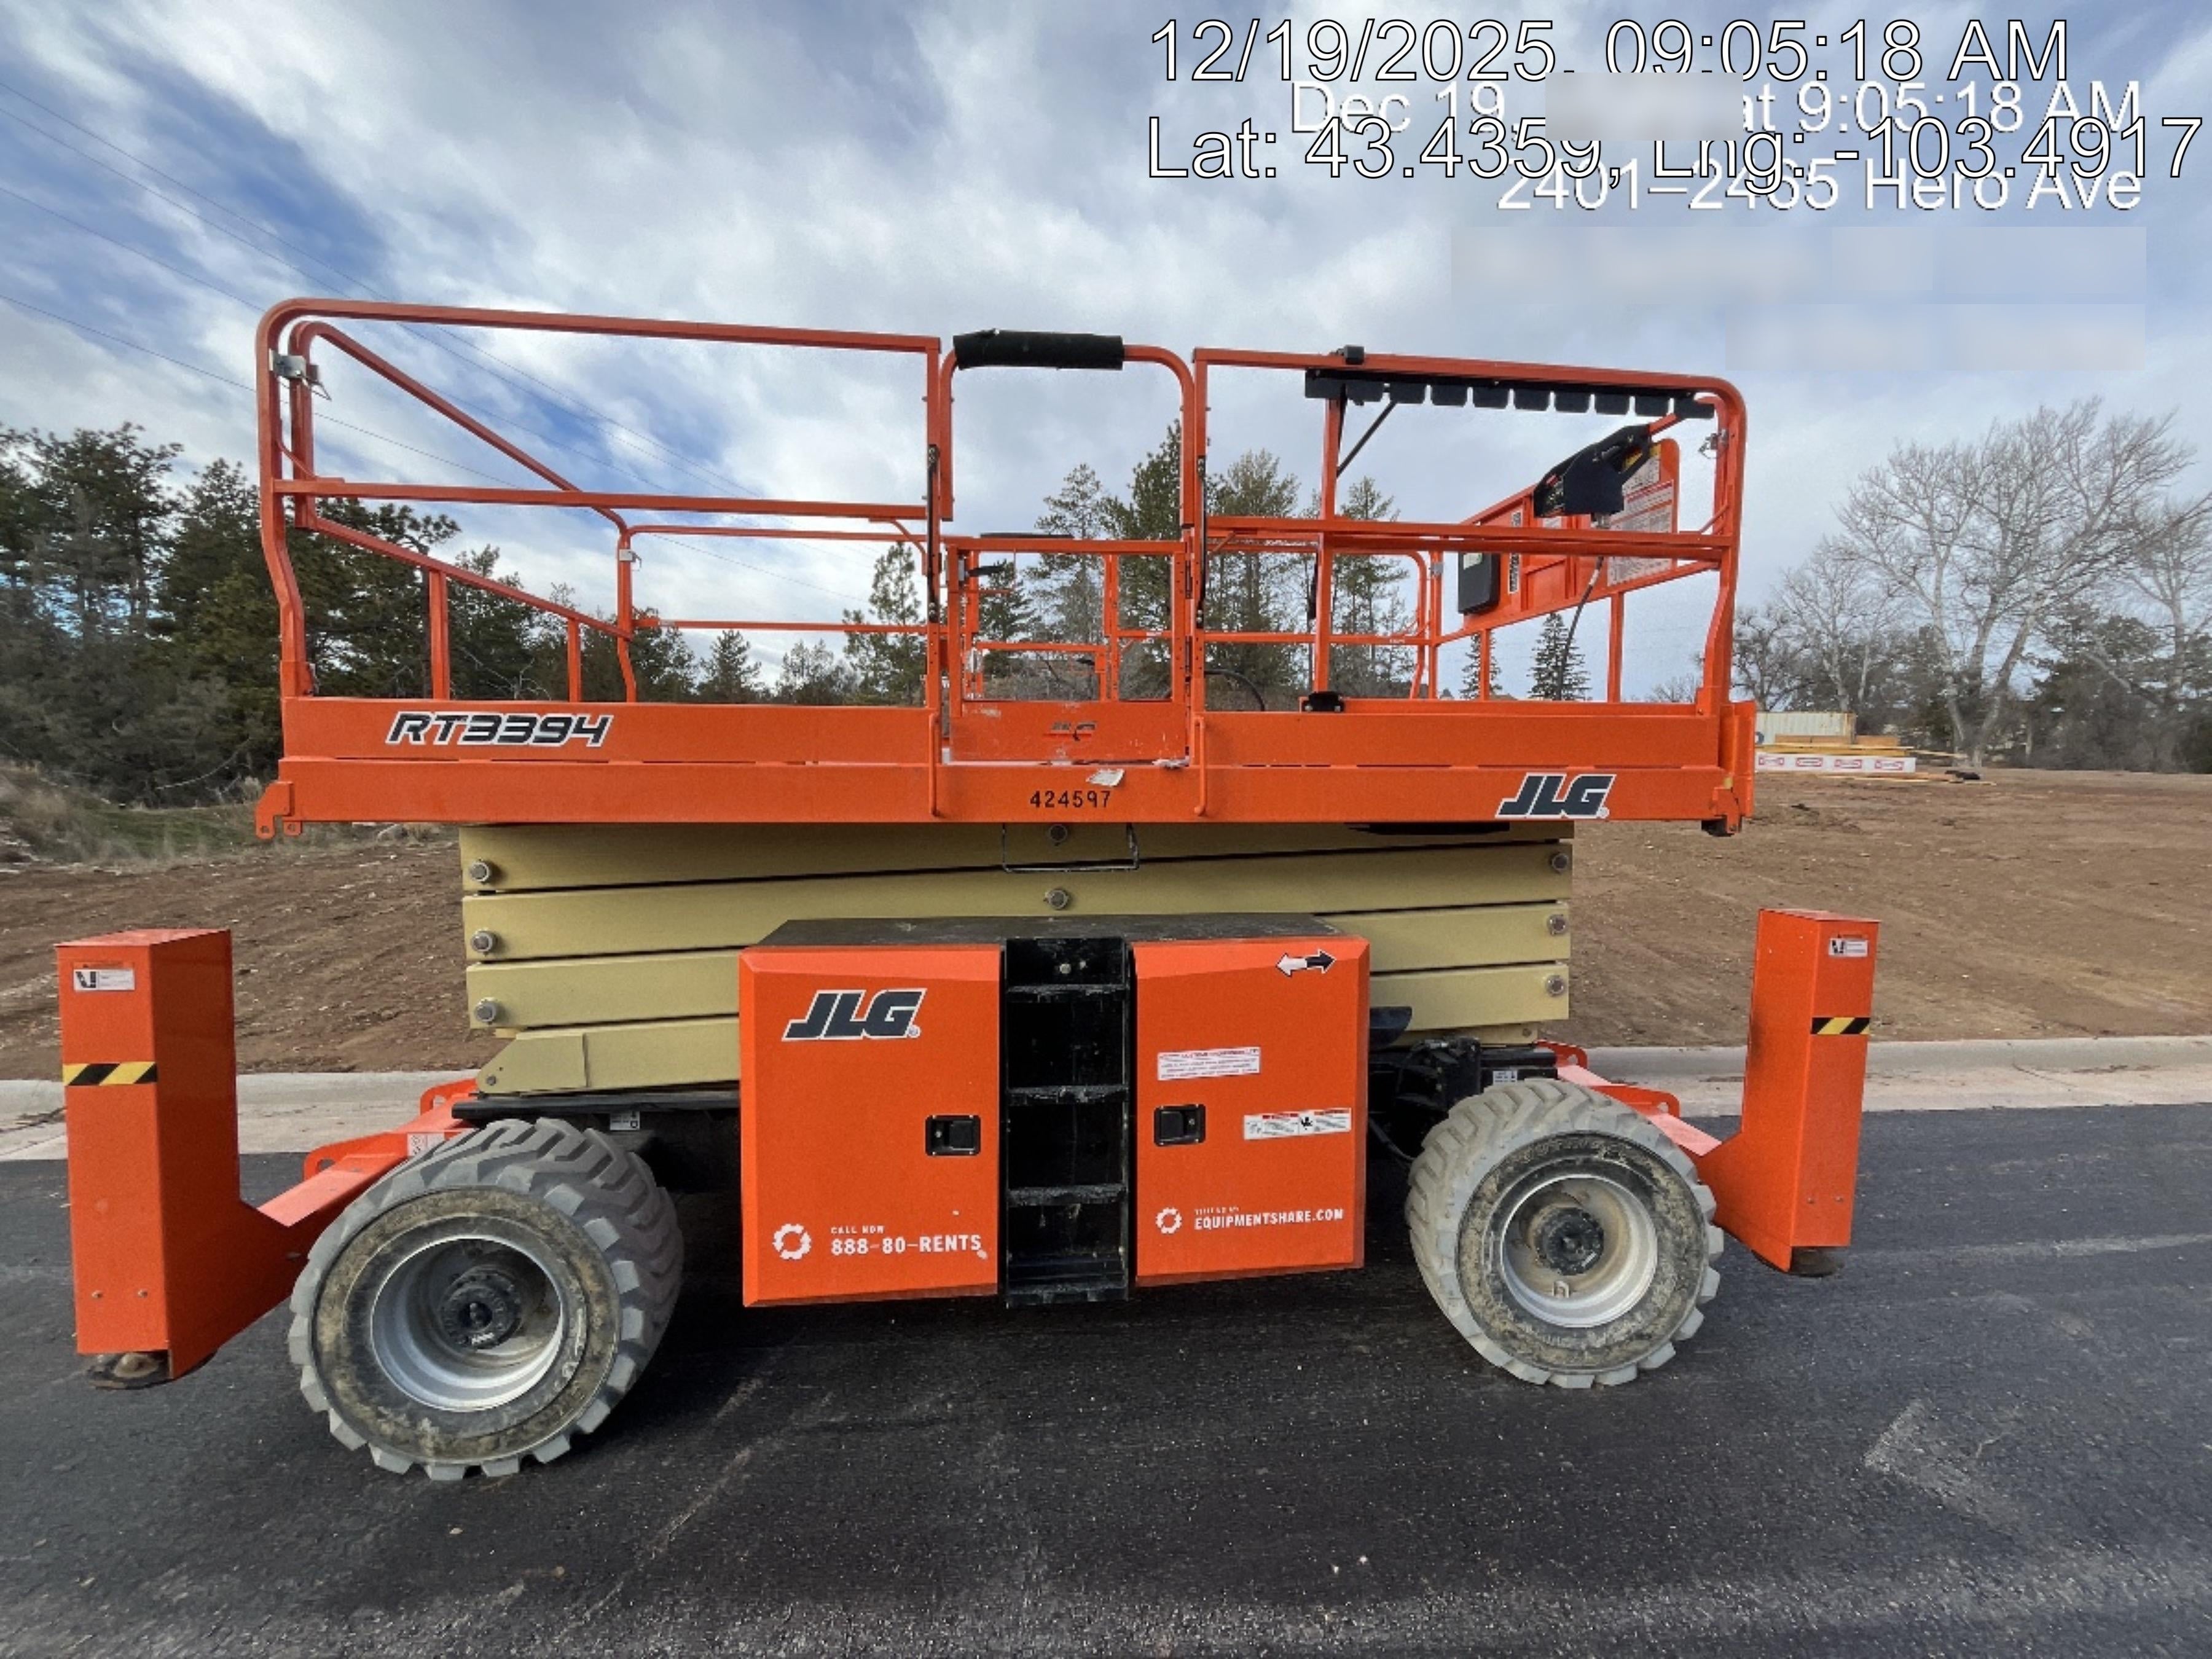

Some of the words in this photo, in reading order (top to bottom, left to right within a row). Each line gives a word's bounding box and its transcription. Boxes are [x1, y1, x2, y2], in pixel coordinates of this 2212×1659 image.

[385, 711, 614, 747] RT3394
[1030, 790, 1111, 808] 424597
[1495, 772, 1617, 819] JLG
[782, 988, 928, 1041] JLG
[830, 1225, 857, 1234] CALL
[861, 1225, 885, 1234] NOW
[1194, 1209, 1343, 1230] EQUIPMENTSHARE.COM
[831, 1234, 981, 1255] 888-80-RENTS
